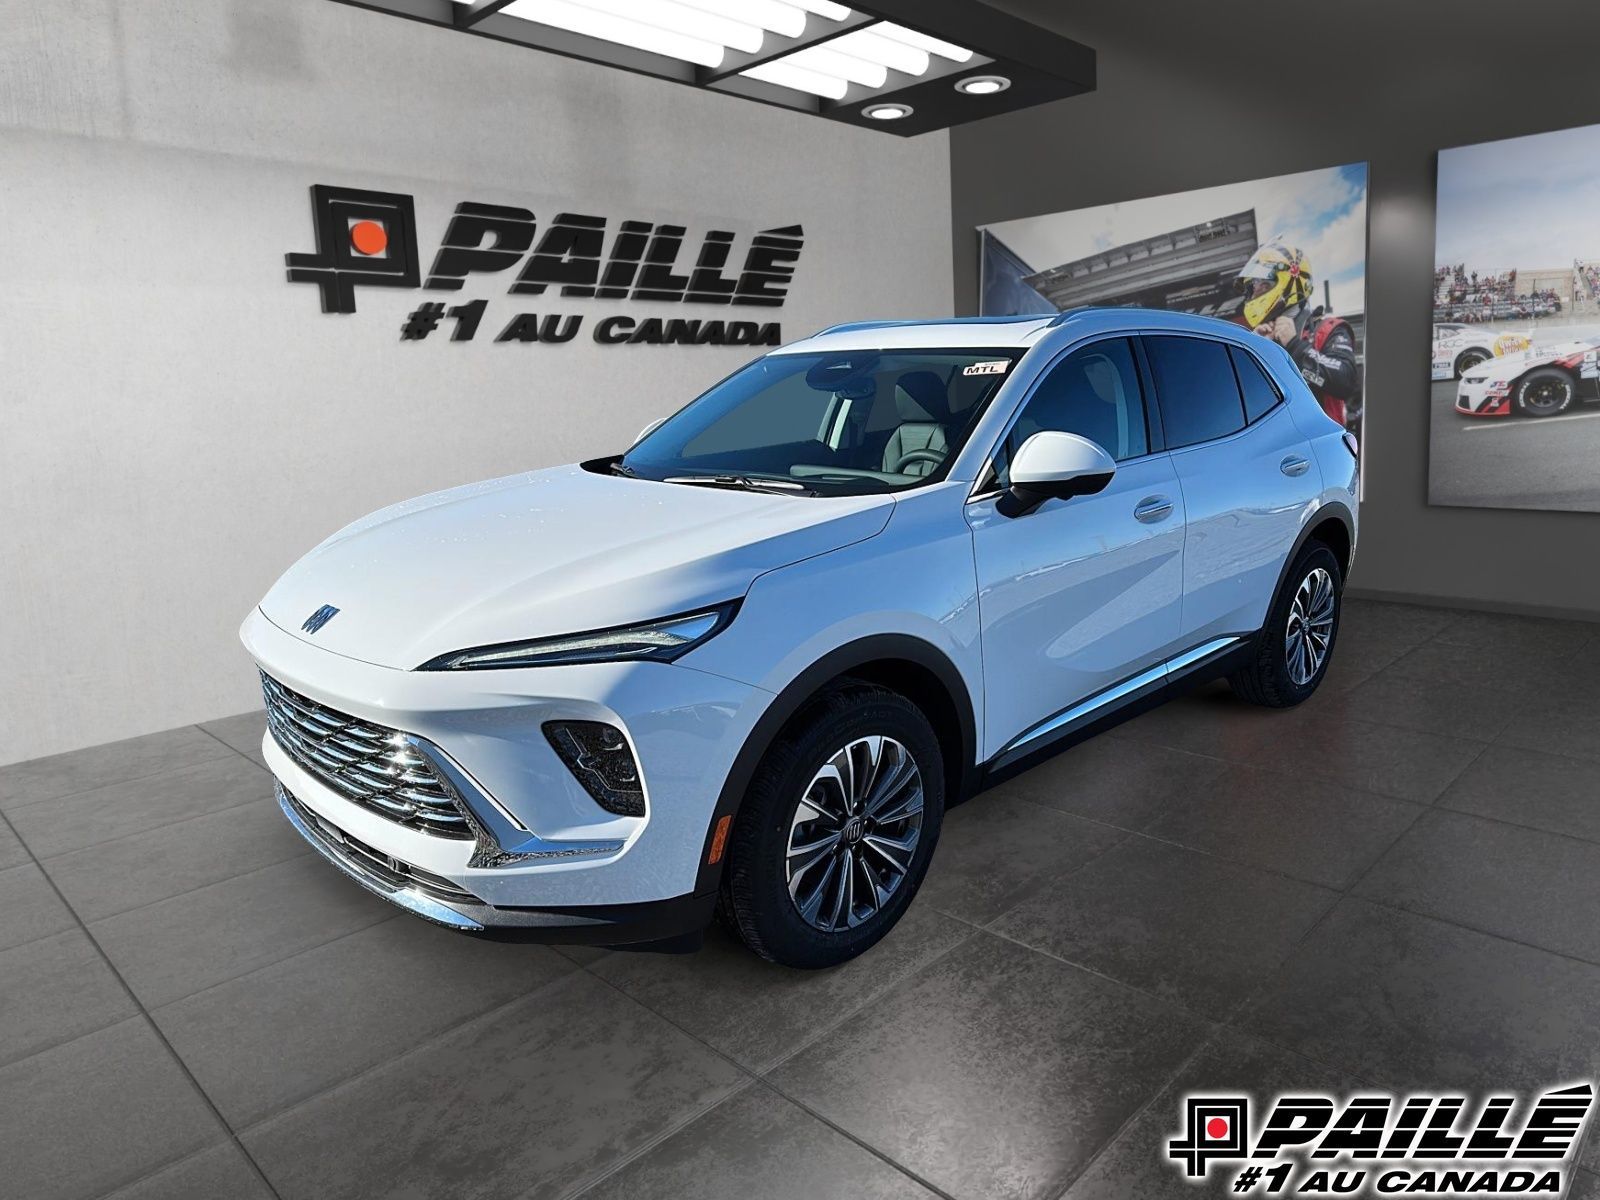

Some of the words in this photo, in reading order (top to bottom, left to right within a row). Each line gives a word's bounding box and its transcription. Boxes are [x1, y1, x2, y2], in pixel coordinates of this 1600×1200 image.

[422, 201, 804, 308] PAILLÉ
[400, 299, 489, 342] #1
[494, 313, 584, 344] AU
[593, 316, 782, 346] CANADA
[966, 365, 999, 375] MTL
